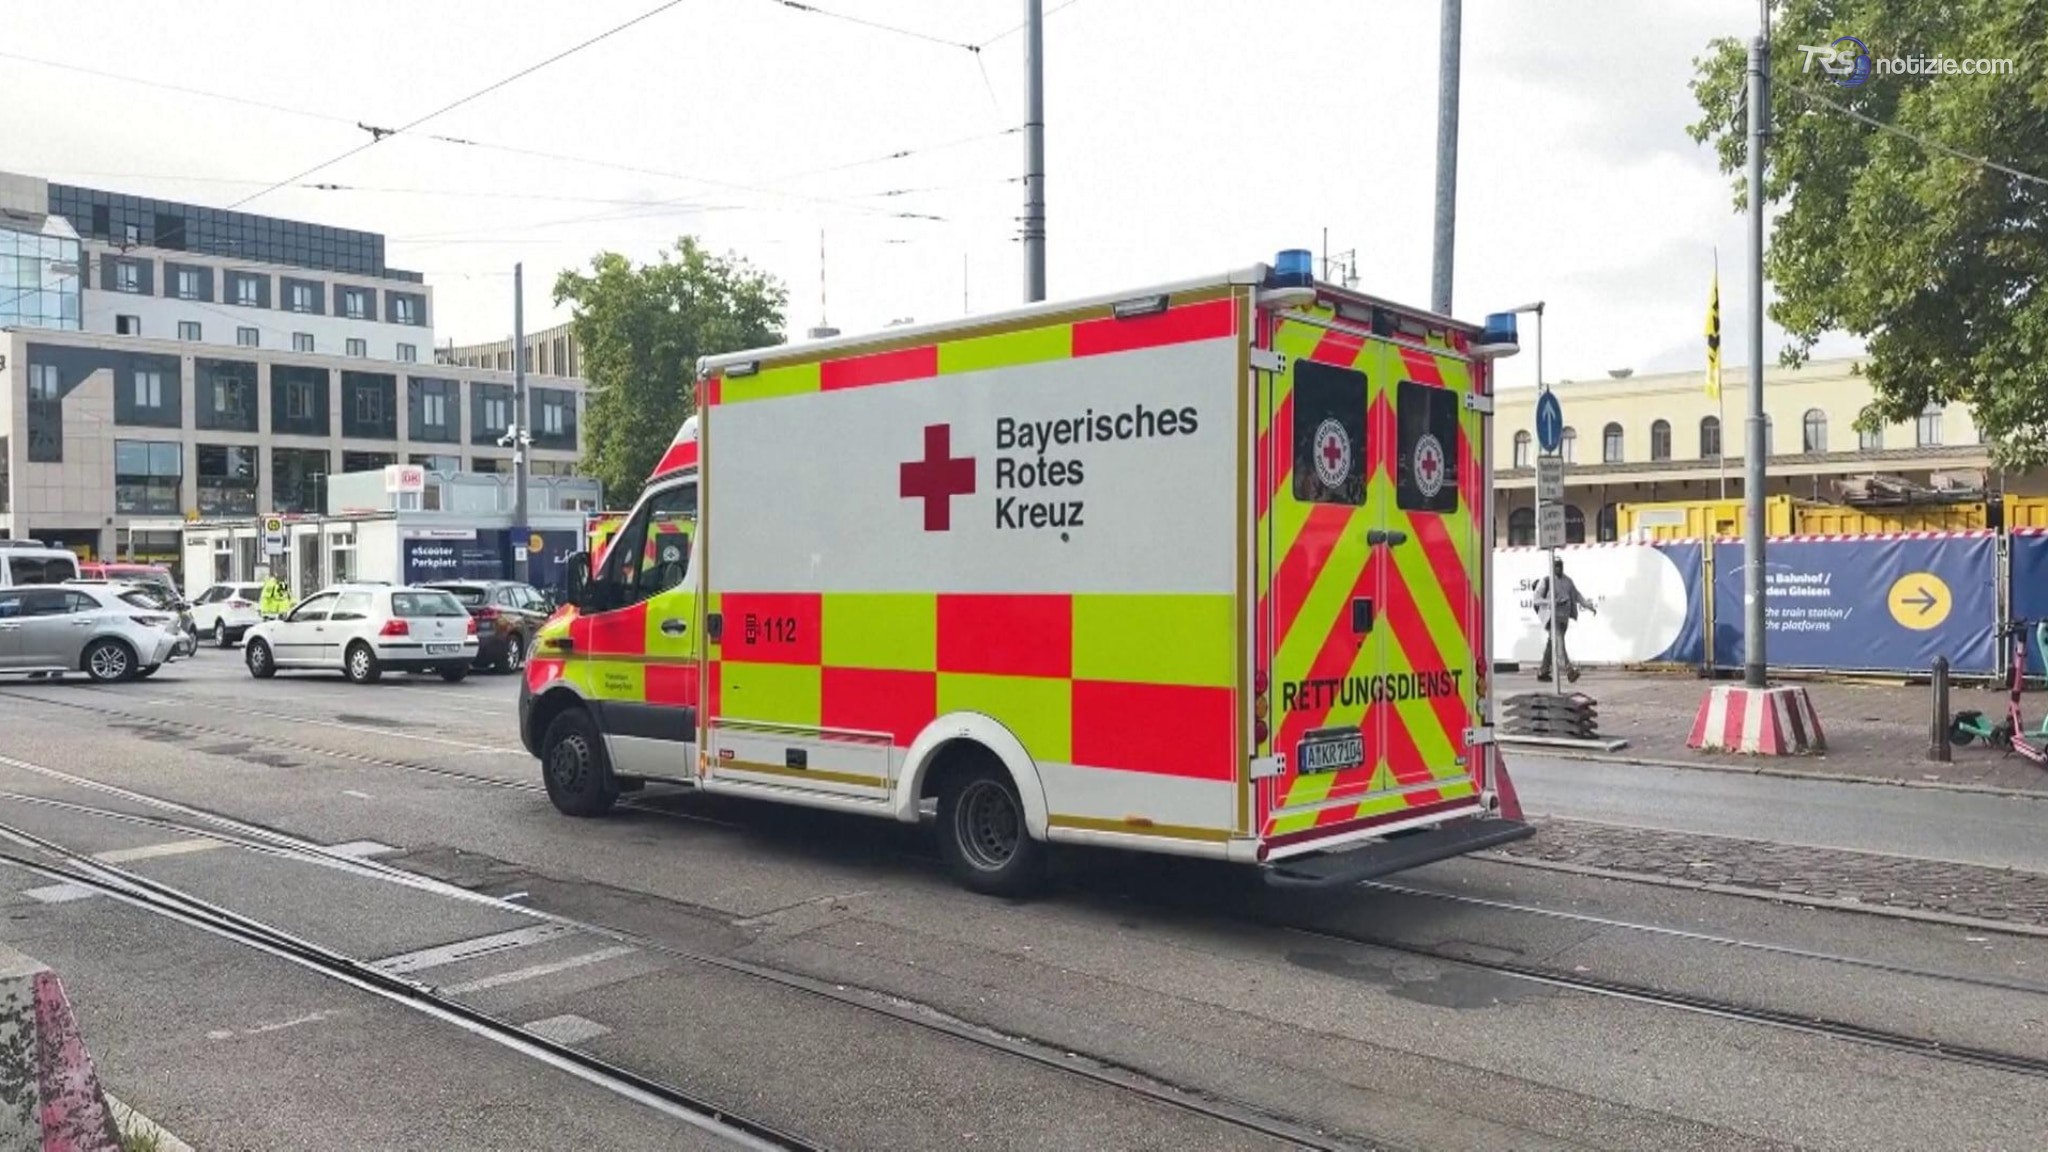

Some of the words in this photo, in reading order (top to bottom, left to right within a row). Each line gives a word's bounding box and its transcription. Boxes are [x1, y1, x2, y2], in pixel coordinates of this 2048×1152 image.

[996, 404, 1199, 455] Bayerisches
[996, 456, 1084, 490] Rotes
[995, 497, 1085, 529] Kreuz
[411, 547, 453, 556] eScooter
[1775, 573, 1823, 584] Bahnhof
[1788, 586, 1831, 596] Gleisen
[1781, 607, 1806, 617] train
[1807, 607, 1843, 619] station
[764, 617, 796, 642] 112
[1781, 620, 1831, 632] platforms
[1282, 669, 1463, 712] RETTUNGSDIENST
